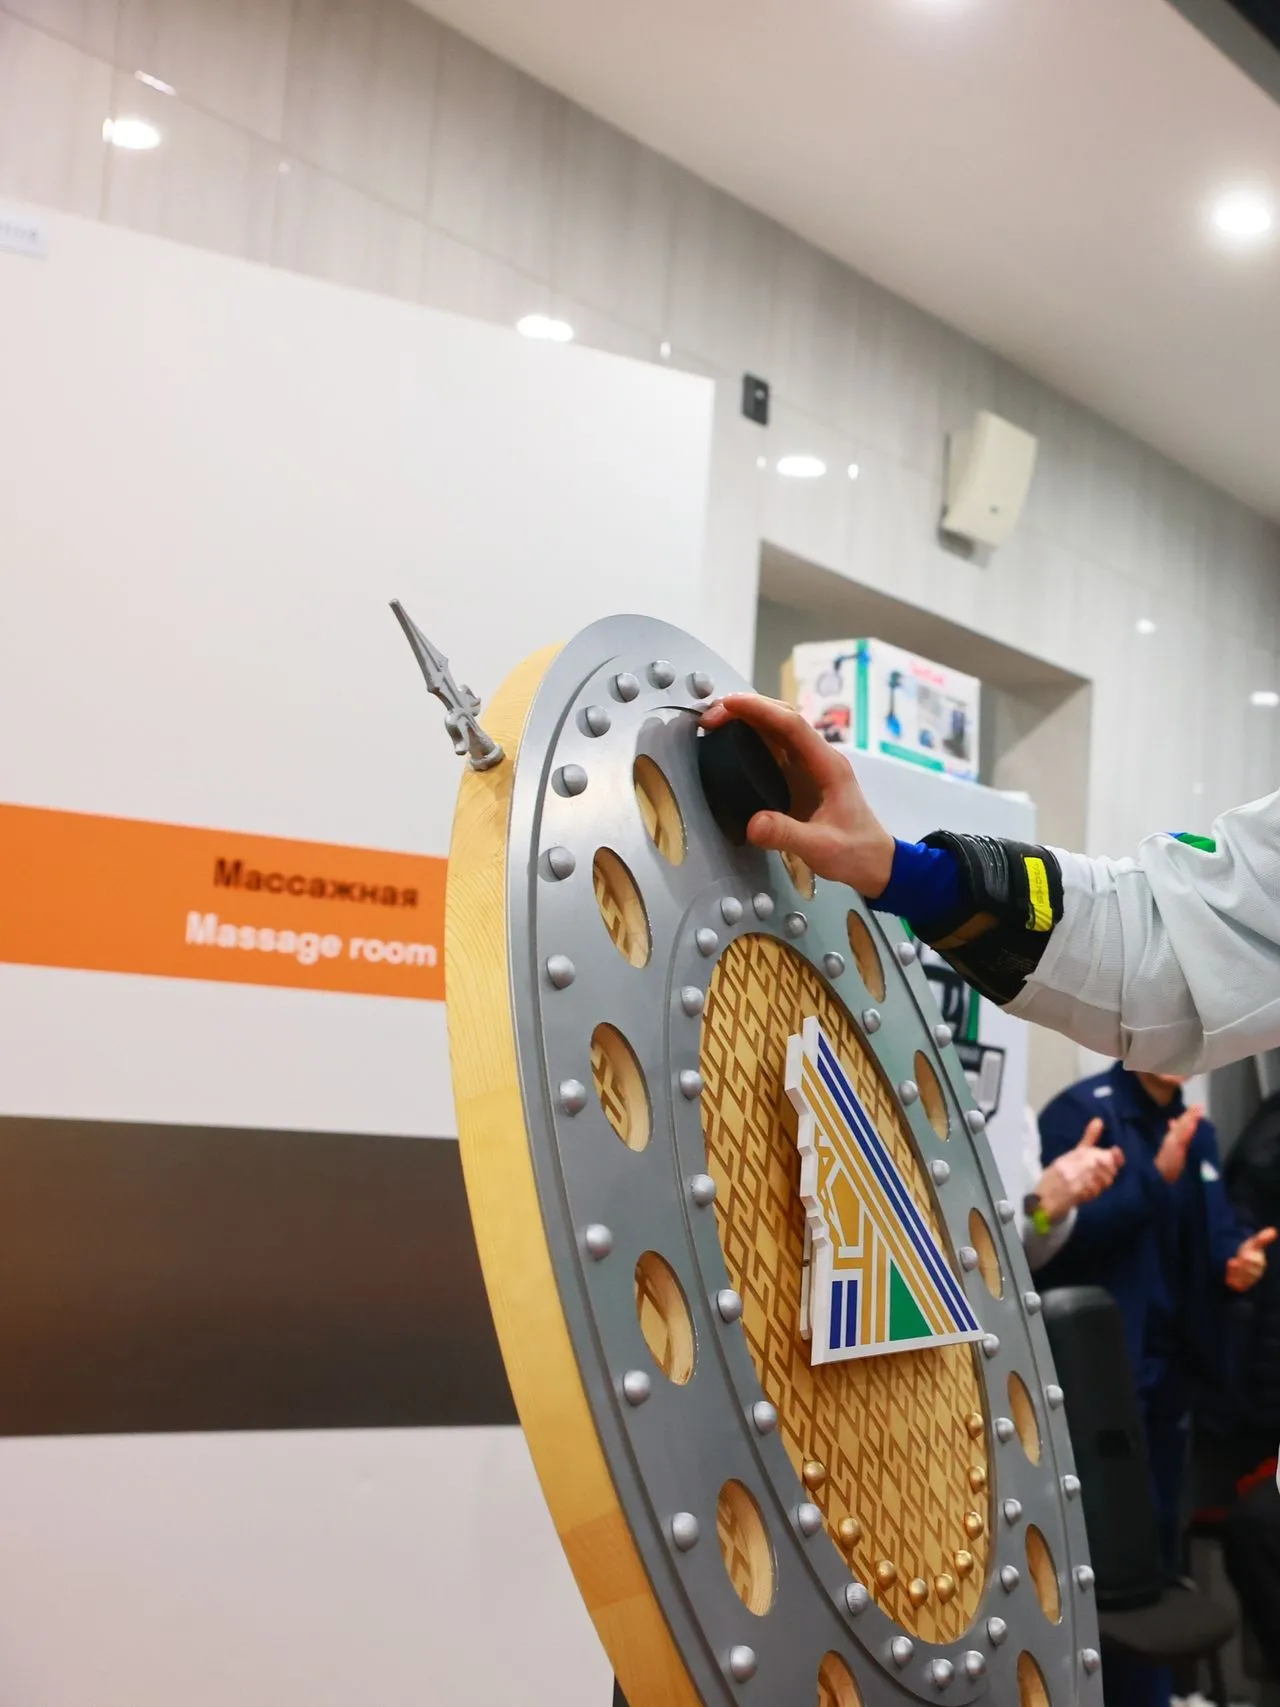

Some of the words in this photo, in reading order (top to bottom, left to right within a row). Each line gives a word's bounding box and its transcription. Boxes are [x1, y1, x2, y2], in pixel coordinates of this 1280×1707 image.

[213, 857, 420, 909] Массажная
[184, 909, 343, 966] Massage
[347, 935, 439, 968] room
